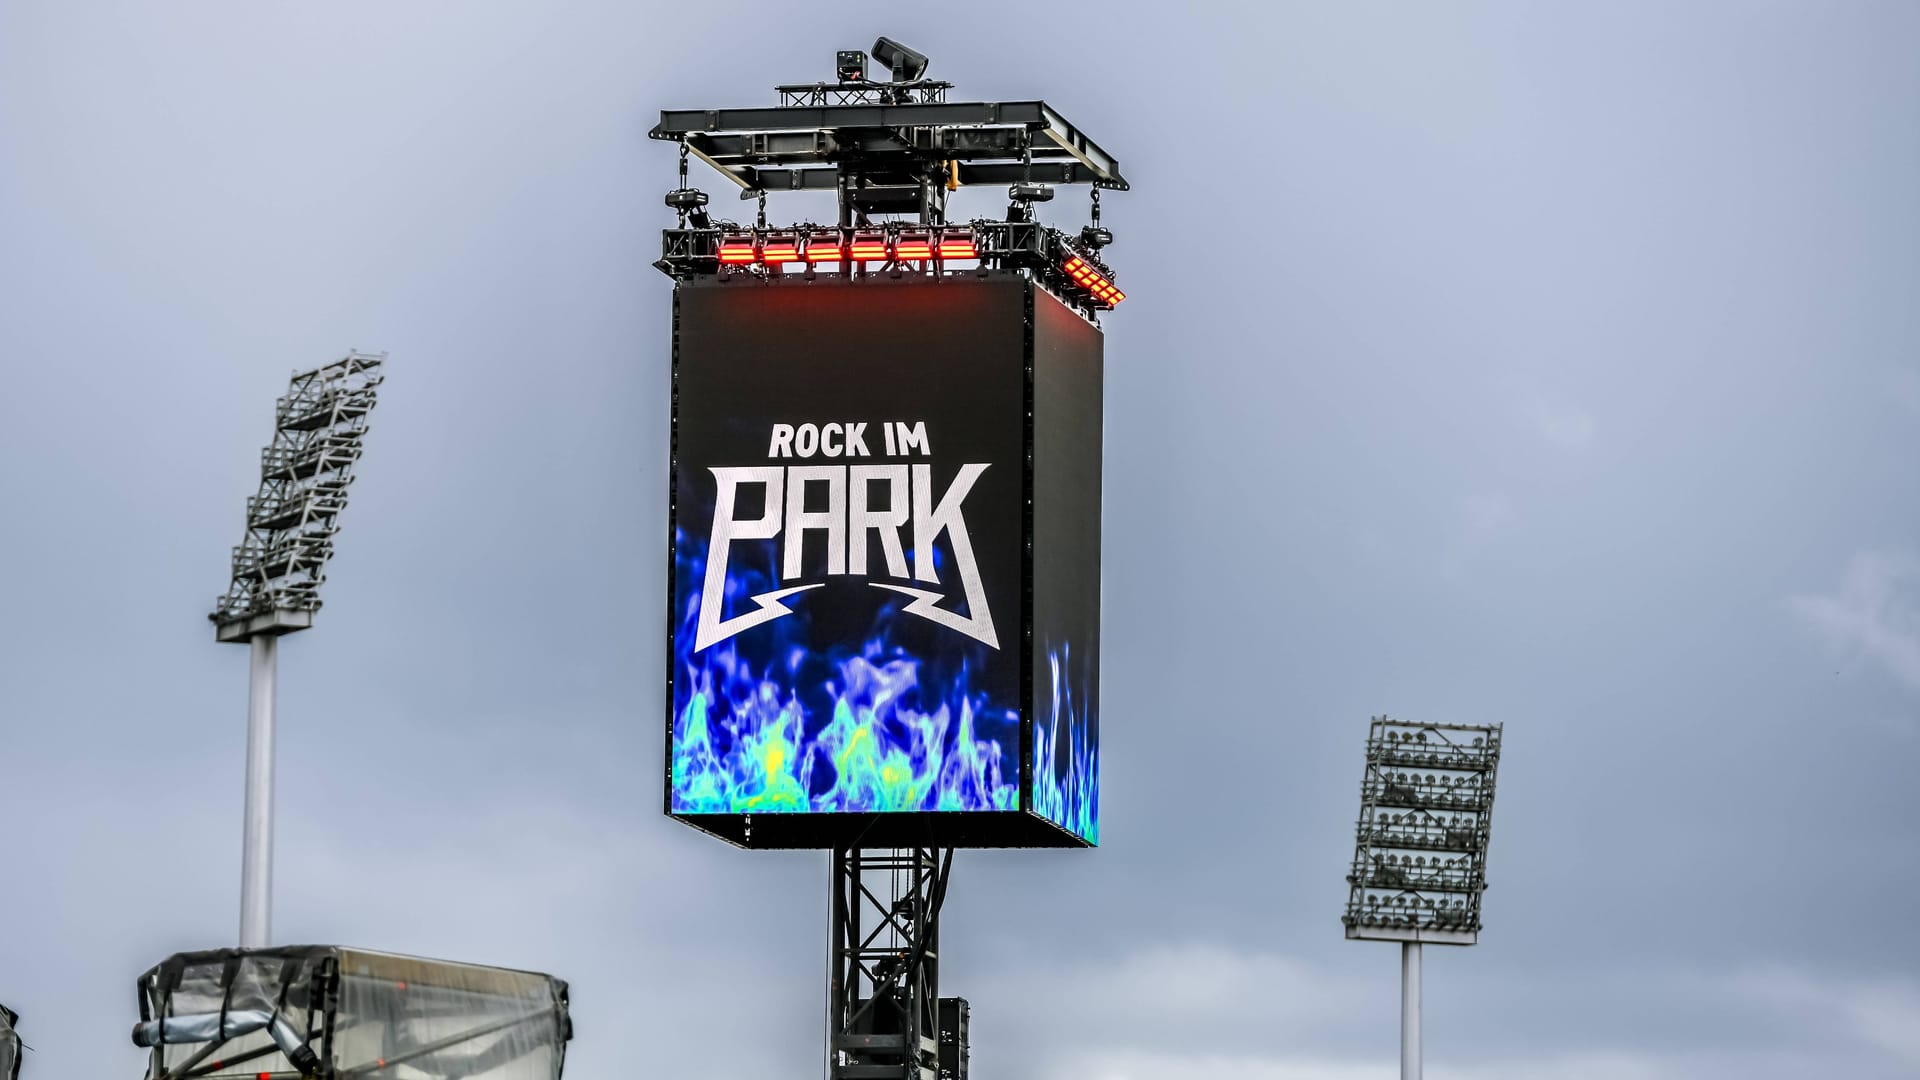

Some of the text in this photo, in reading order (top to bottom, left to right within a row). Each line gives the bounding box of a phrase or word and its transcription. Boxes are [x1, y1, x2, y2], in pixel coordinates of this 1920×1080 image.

[768, 421, 931, 458] ROCK IM
[694, 463, 1001, 653] PARK
